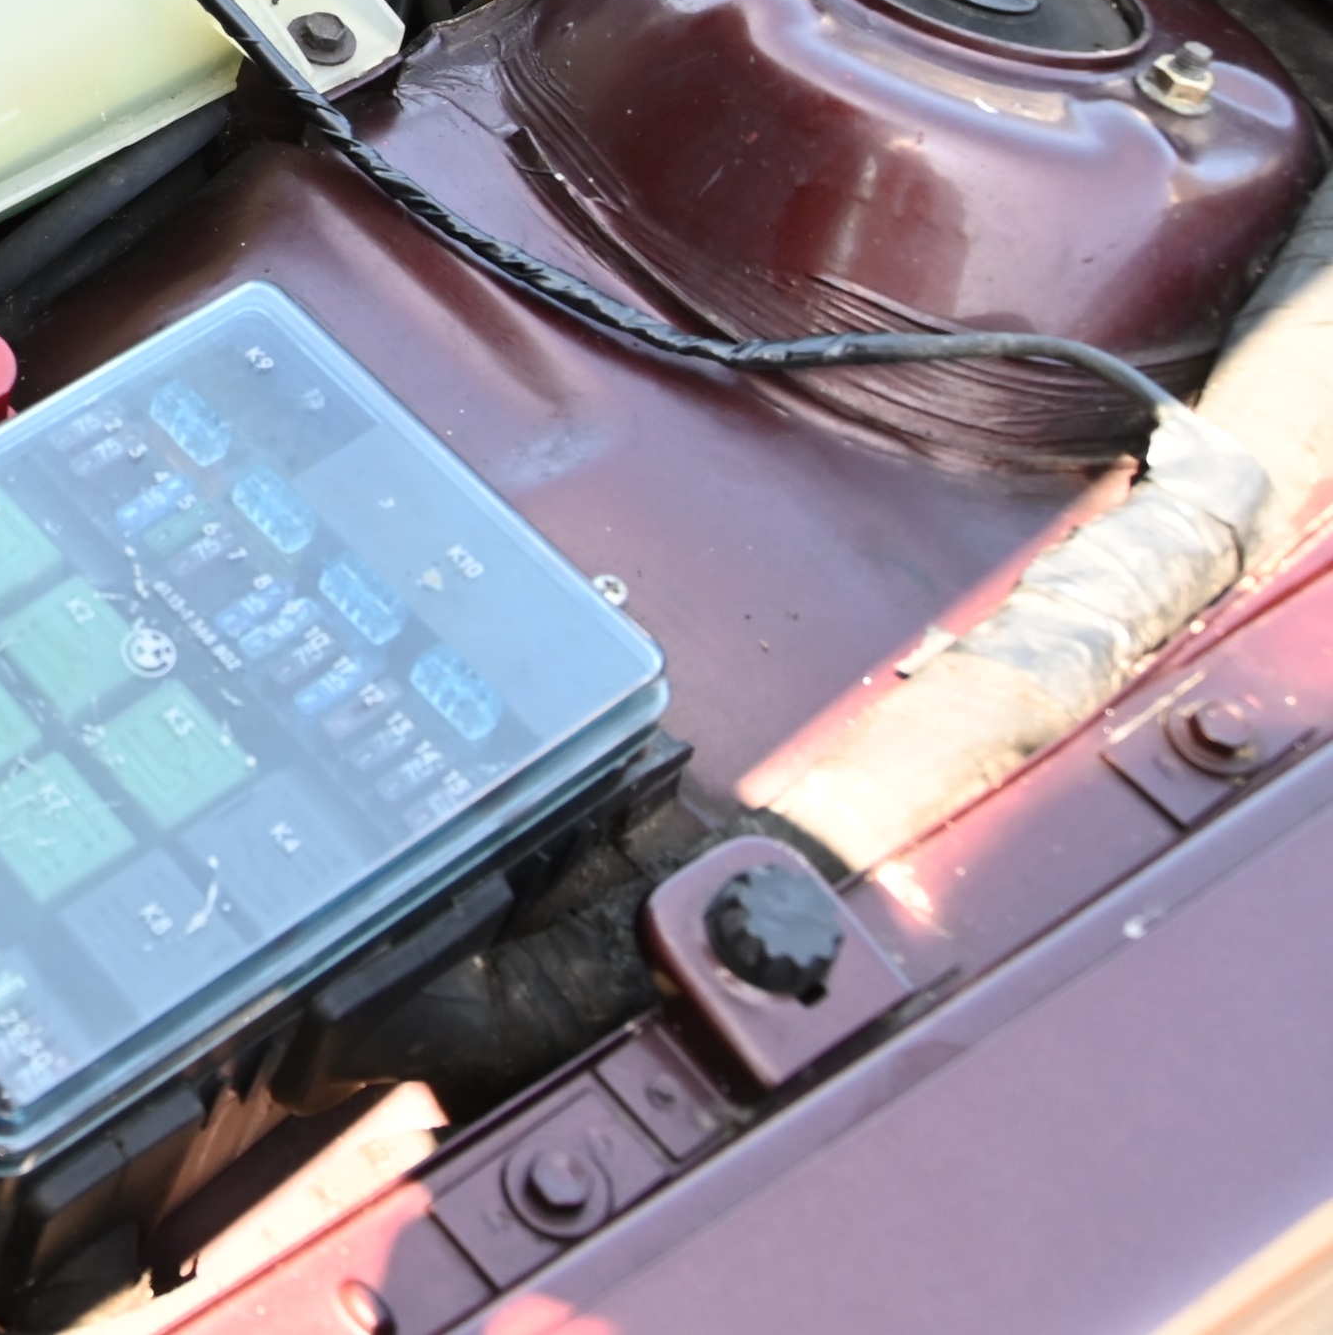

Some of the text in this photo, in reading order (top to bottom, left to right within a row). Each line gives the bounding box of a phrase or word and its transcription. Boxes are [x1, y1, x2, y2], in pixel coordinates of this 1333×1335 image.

[245, 346, 274, 369] K9
[445, 543, 484, 578] K10
[65, 597, 96, 624] K2
[104, 418, 123, 433] 2
[128, 443, 148, 458] 3
[153, 470, 170, 483] 4
[177, 494, 196, 509] 5
[202, 522, 222, 536] 6
[227, 546, 248, 559] 7
[252, 573, 273, 590] 8
[358, 682, 384, 708] 12
[386, 711, 414, 737] 13
[415, 740, 444, 764] 14
[443, 769, 471, 797] 15
[162, 705, 195, 736] K3
[270, 822, 301, 853] K4
[139, 902, 173, 935] K8
